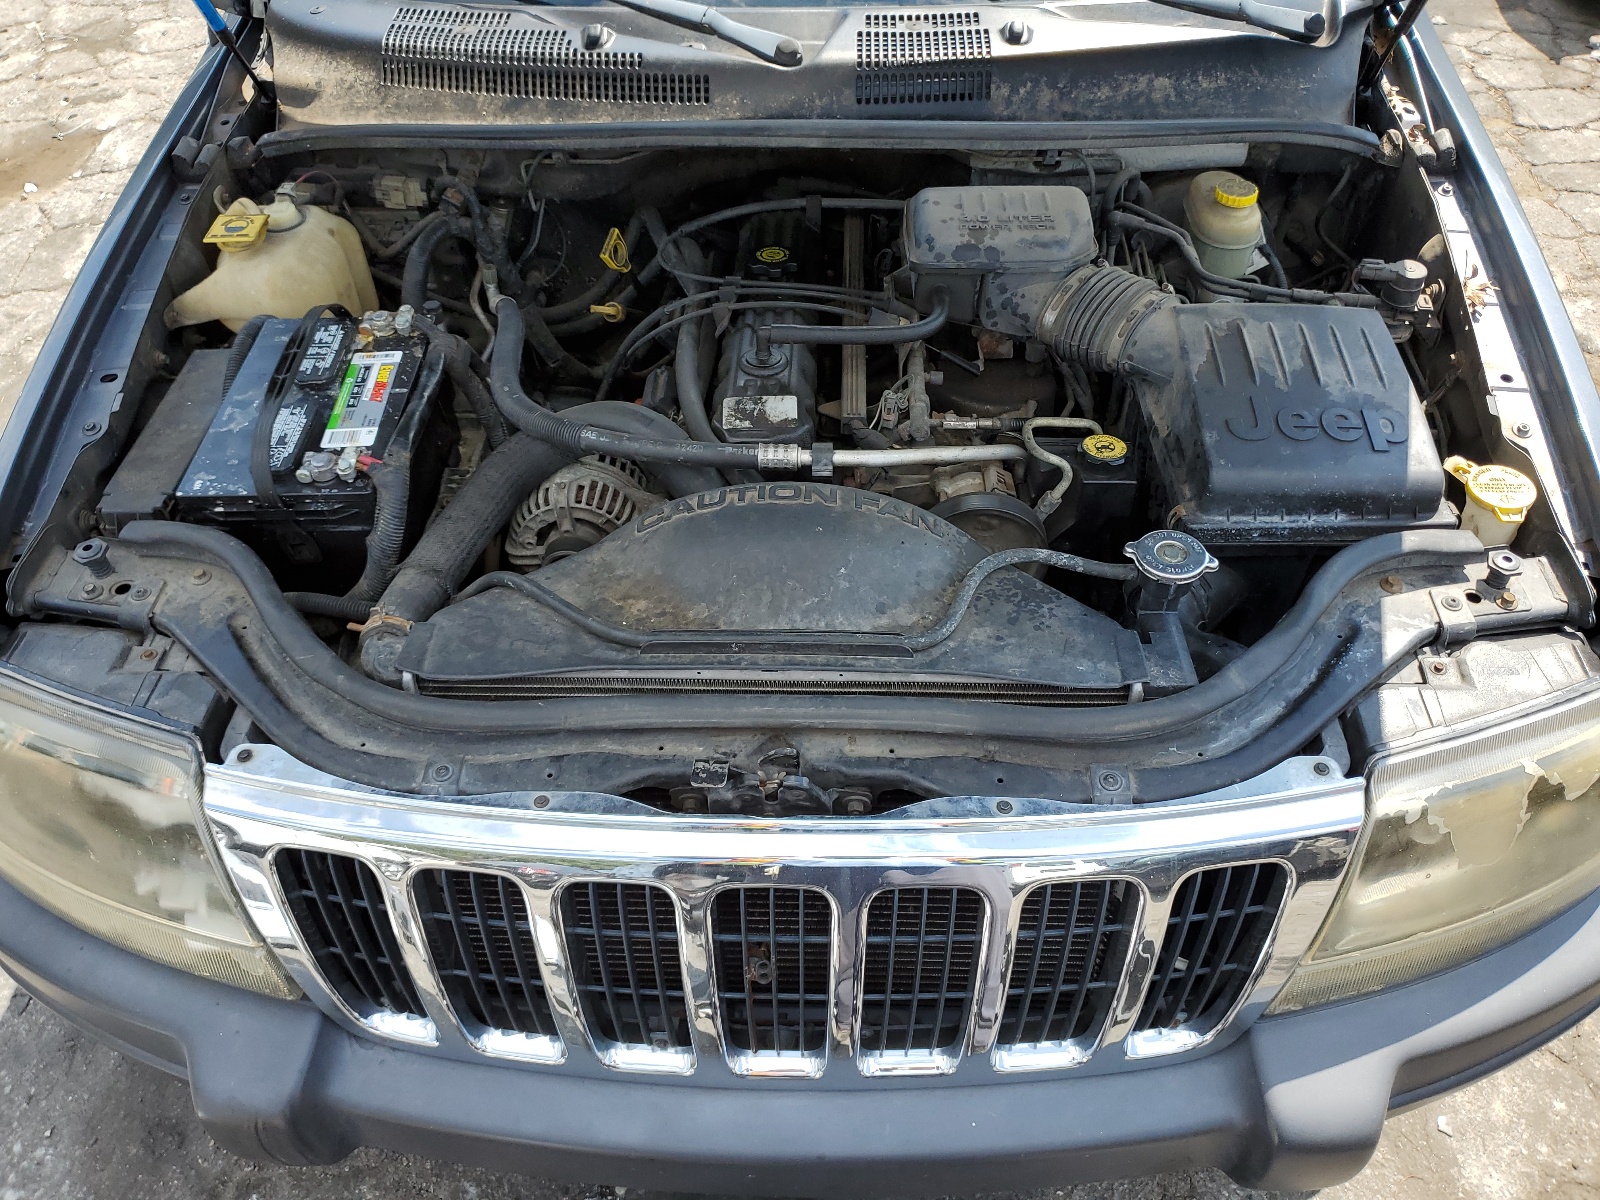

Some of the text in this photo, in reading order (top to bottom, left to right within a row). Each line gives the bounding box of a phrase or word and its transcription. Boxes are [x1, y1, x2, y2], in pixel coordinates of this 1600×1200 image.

[1224, 394, 1409, 453] Jeep
[635, 484, 945, 538] CAUTION FAN
